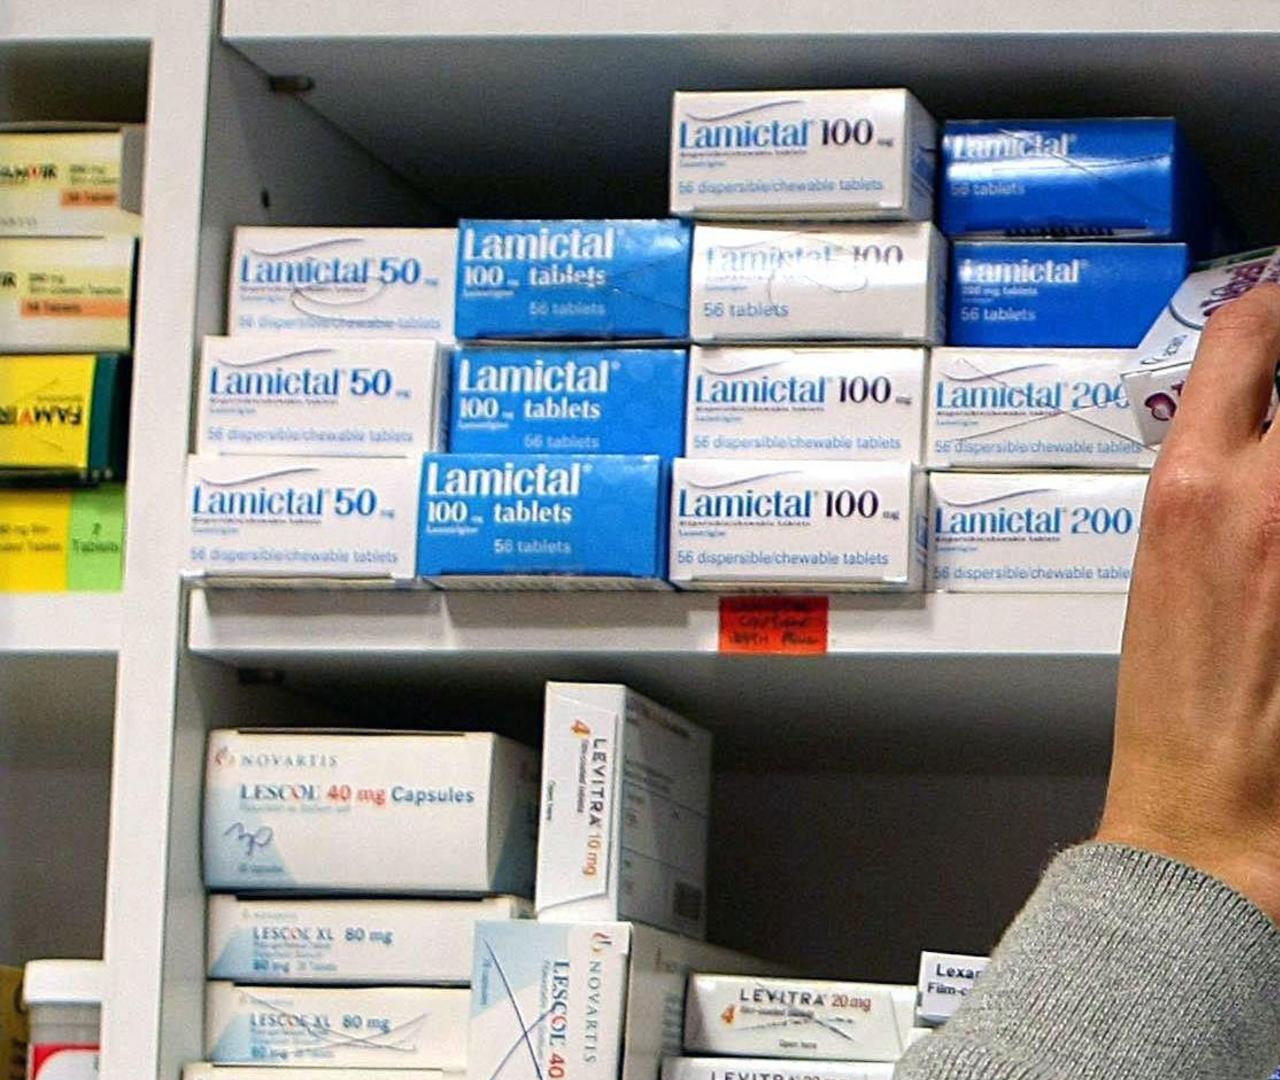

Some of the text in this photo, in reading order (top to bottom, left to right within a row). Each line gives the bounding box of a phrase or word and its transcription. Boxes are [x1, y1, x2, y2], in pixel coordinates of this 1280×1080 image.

[821, 118, 874, 145] 100
[350, 369, 392, 395] 50
[459, 397, 600, 418] 100 tablets
[824, 489, 878, 518] 100
[677, 550, 694, 566] 56
[843, 551, 889, 566] tablets
[241, 753, 338, 768] NOVARTIS
[240, 785, 474, 806] LESCOL 40 mg Capsules
